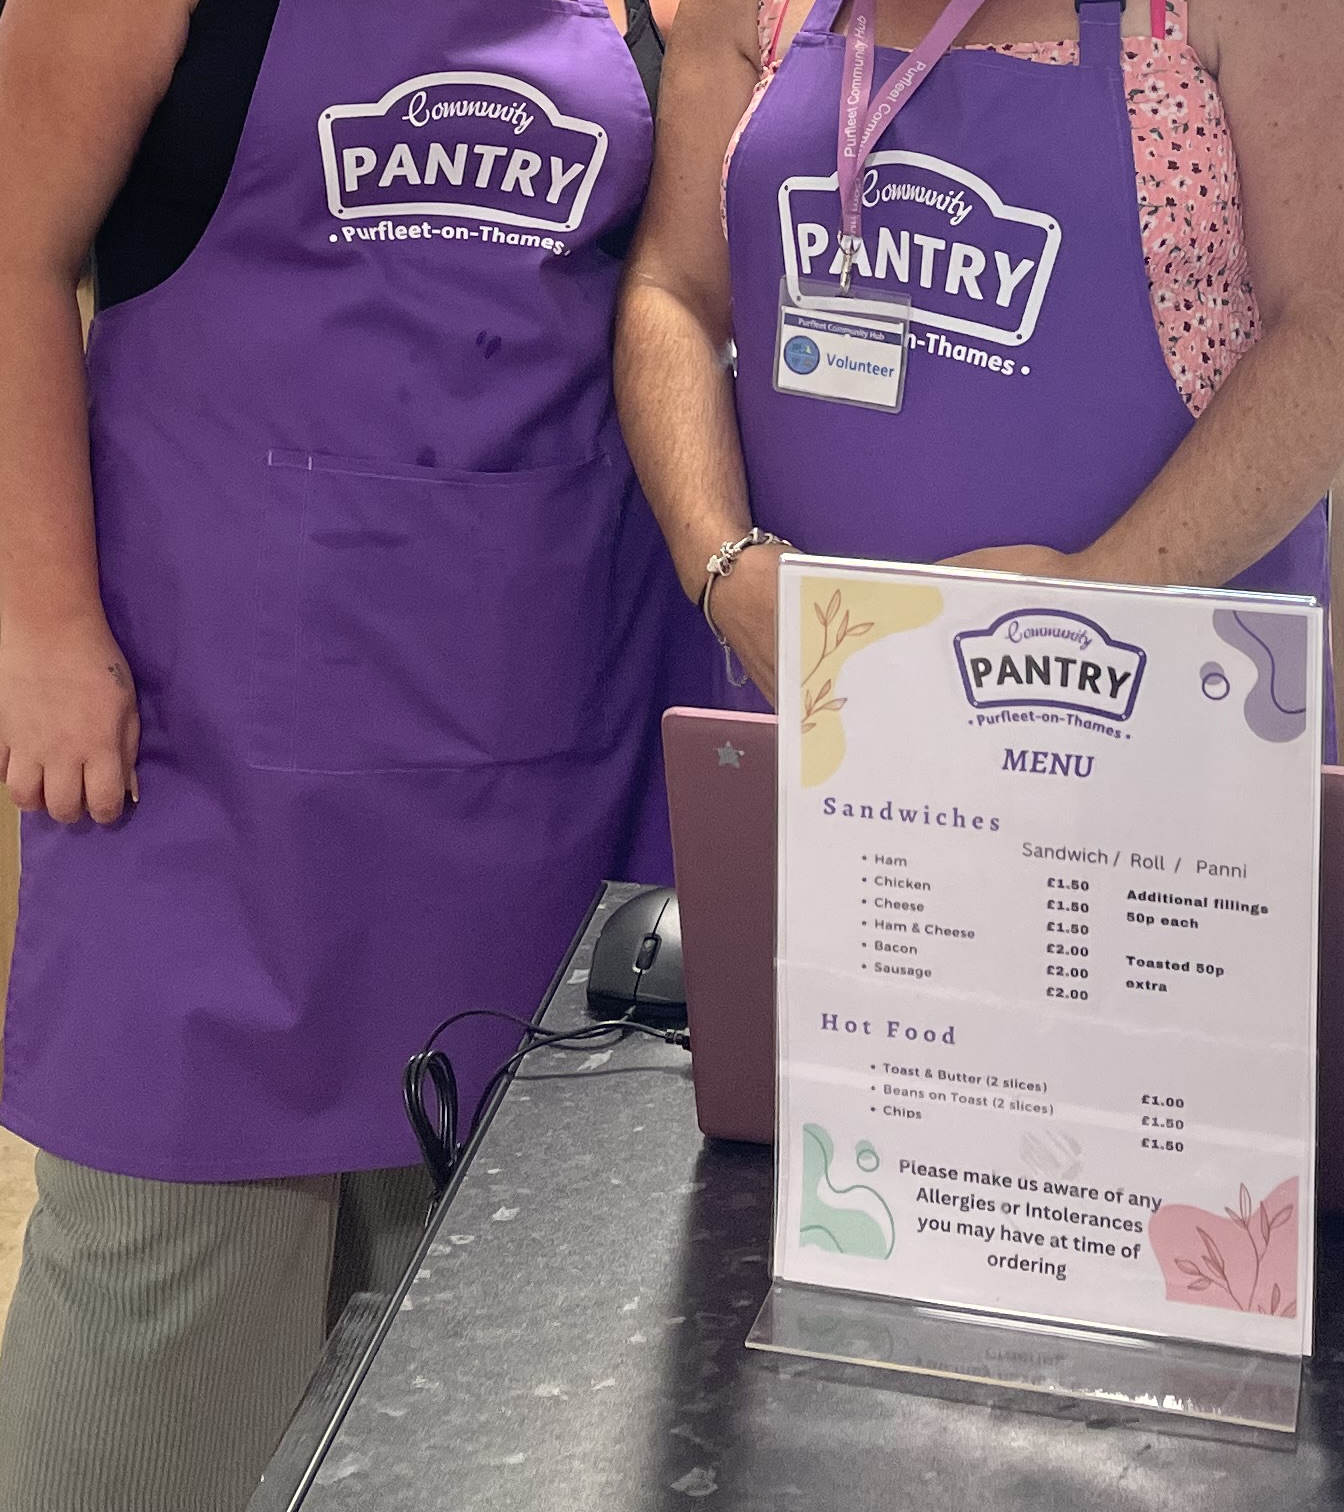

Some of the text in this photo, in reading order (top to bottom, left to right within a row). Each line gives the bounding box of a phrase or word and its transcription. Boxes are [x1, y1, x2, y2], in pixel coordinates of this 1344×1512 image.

[854, 15, 867, 39] Hub
[847, 40, 868, 105] Community
[402, 91, 534, 134] Community
[342, 142, 584, 204] PANTRY
[861, 169, 972, 226] Community
[342, 221, 565, 255] Purfleet-on-Thames
[797, 222, 1035, 307] PANTRY
[827, 323, 868, 339] Community
[869, 330, 885, 341] Hub
[826, 352, 895, 377] Volunteer
[1005, 620, 1092, 651] Community
[969, 654, 1131, 699] PANTRY
[976, 710, 1121, 739] Purfleet-on-Thames
[1001, 748, 1094, 777] MENU
[823, 797, 1000, 831] Sandwiches
[874, 854, 907, 867] Ham
[1022, 842, 1108, 865] Sandwich
[1130, 853, 1165, 871] Roll
[1196, 859, 1247, 879] Panni
[874, 876, 931, 891] Chicken
[1047, 877, 1089, 892] £1.50
[874, 897, 924, 912] Cheese
[1047, 899, 1089, 914] £1.50
[1127, 890, 1269, 916] Additional fillings
[874, 919, 975, 939] Ham & Cheese
[1047, 921, 1089, 935] £1.50
[1127, 912, 1199, 929] 50p each
[874, 940, 918, 955] Bacon
[1047, 943, 1089, 957] £2.00
[874, 962, 932, 979] Sausage
[1046, 965, 1088, 979] £2.00
[1126, 956, 1225, 977] Toasted 50p
[1046, 987, 1088, 1001] £2.00
[1126, 979, 1168, 992] extra
[821, 1013, 956, 1045] Hot Food
[883, 1063, 1048, 1093] Toast & Butter (2 slices)
[883, 1084, 1054, 1116] Beans on Toast (2 slices)
[1141, 1094, 1184, 1108] £1.00
[883, 1105, 922, 1120] Chips
[1141, 1115, 1184, 1130] £1.50
[1141, 1137, 1184, 1152] £1.50
[899, 1158, 1163, 1213] Please make us aware of any
[916, 1187, 1143, 1233] Allergies or Intolerances
[917, 1216, 1141, 1260] you may have at time of
[987, 1253, 1067, 1281] ordering
